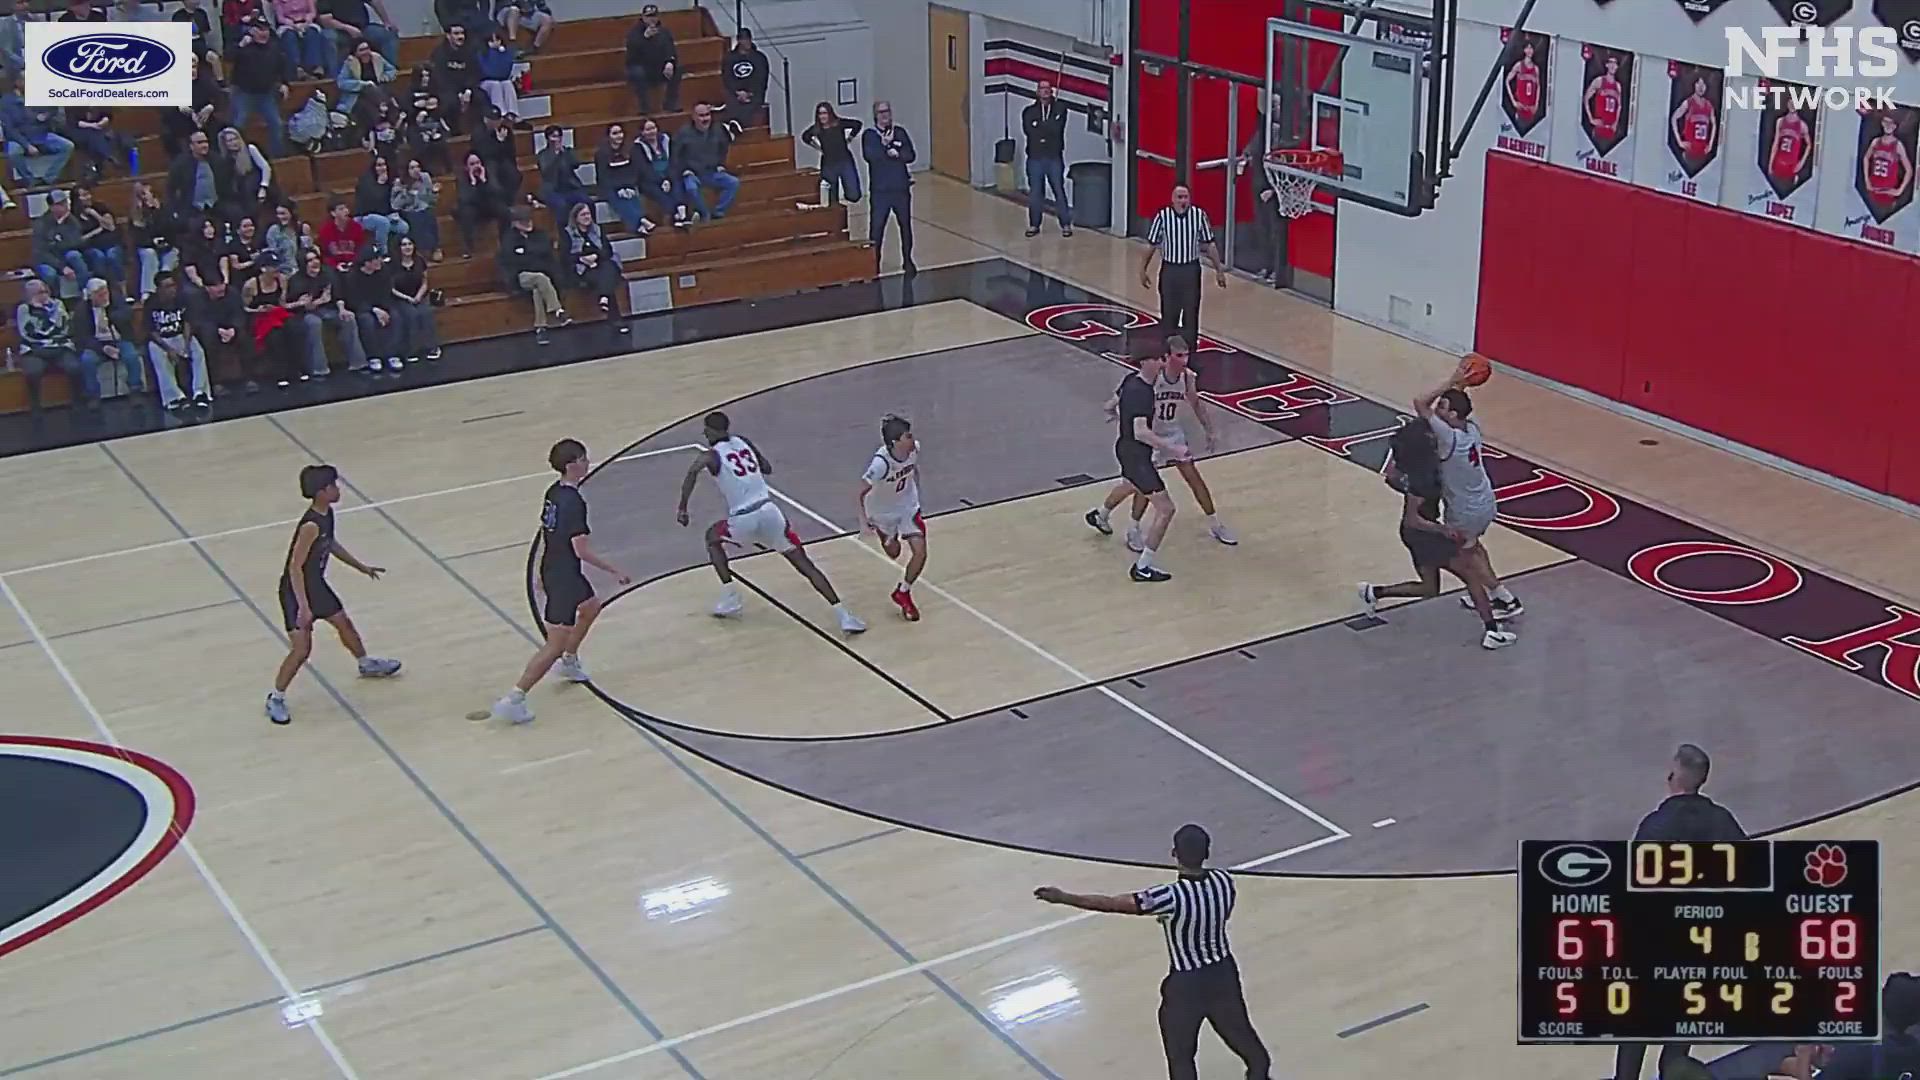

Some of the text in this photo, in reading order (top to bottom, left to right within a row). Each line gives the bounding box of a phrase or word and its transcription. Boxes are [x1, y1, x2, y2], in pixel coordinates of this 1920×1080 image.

[1682, 180, 1697, 196] LEE
[1159, 402, 1177, 420] 10
[726, 448, 758, 477] 33
[896, 477, 907, 493] 0
